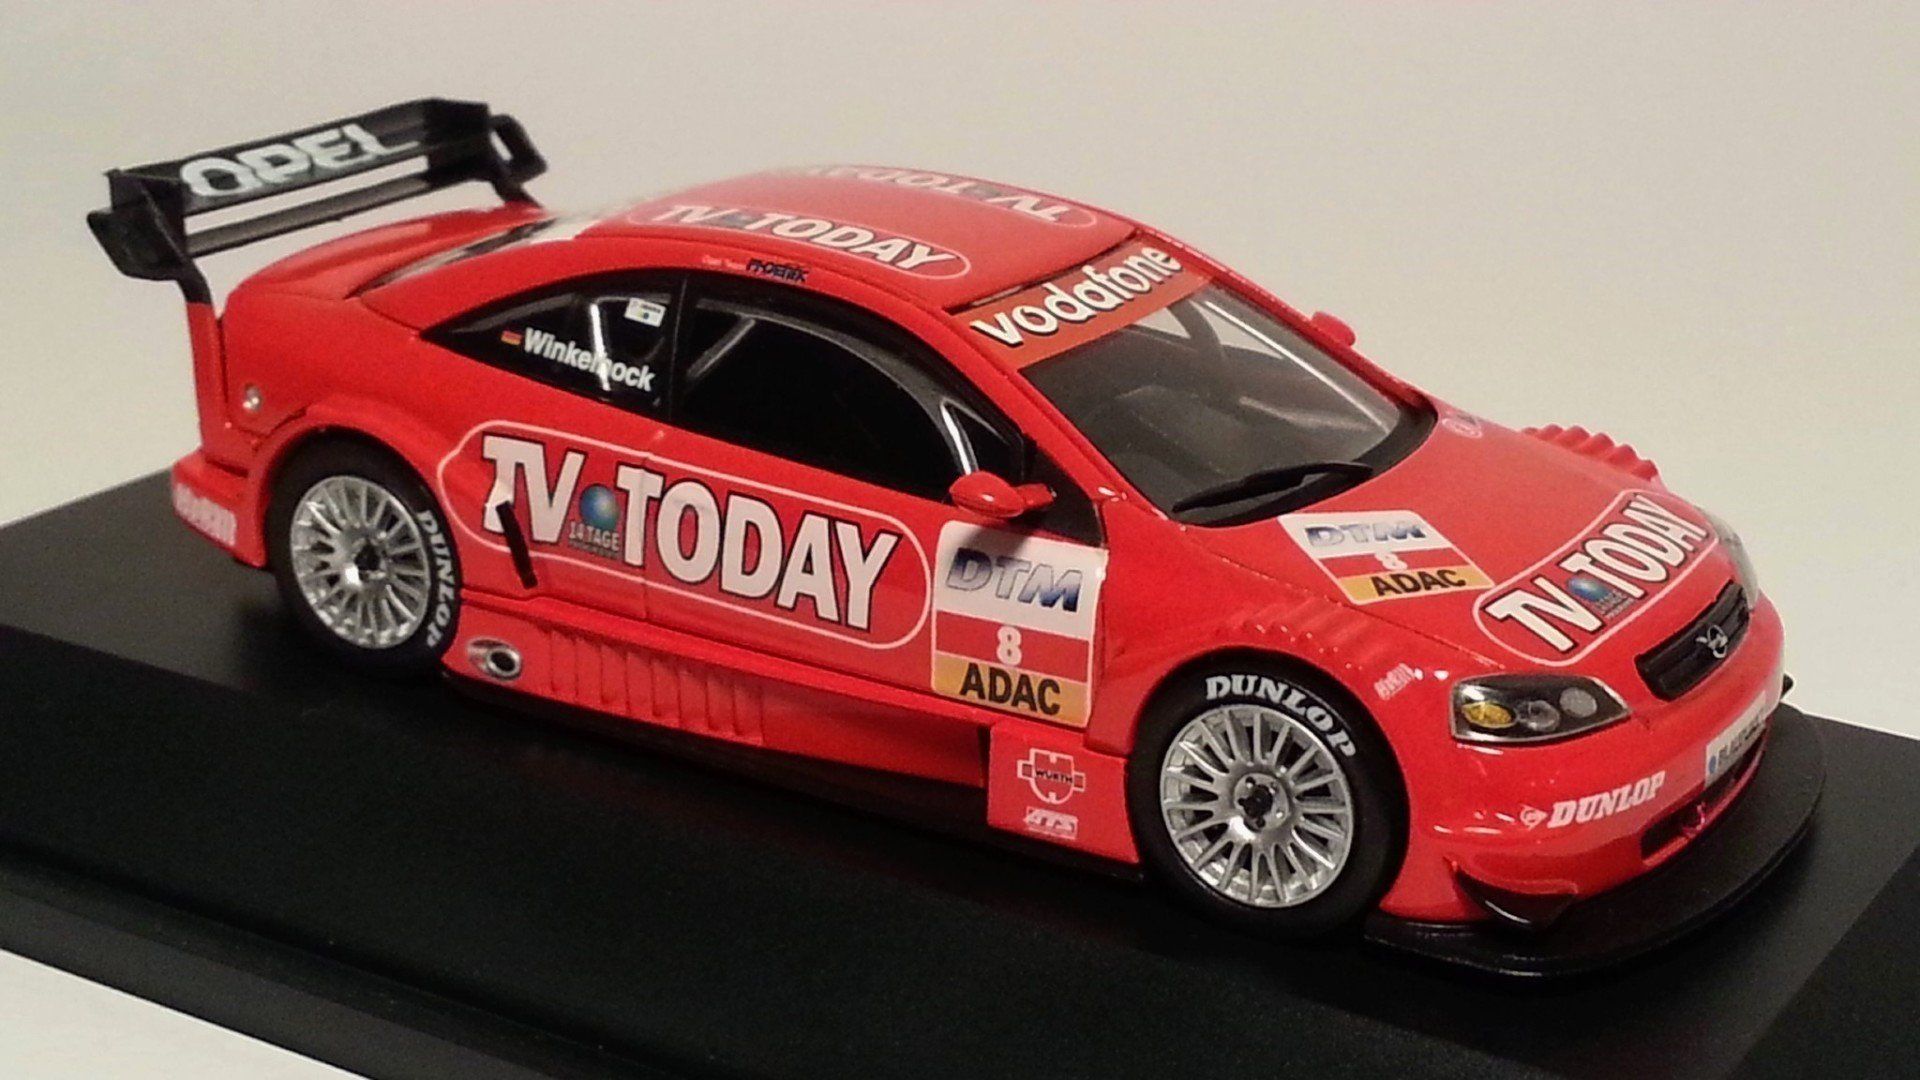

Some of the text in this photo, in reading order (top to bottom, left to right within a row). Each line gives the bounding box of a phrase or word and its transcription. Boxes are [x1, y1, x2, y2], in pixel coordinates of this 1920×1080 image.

[179, 122, 420, 197] OPEL
[651, 204, 741, 224] TV
[742, 212, 957, 270] TODAY
[969, 246, 1184, 346] vodafone
[481, 433, 906, 634] TV TODAY
[1304, 520, 1427, 548] DTM
[1374, 549, 1409, 572] 8
[416, 508, 456, 648] DUNLOP
[945, 546, 1083, 613] DTM
[1370, 569, 1467, 598] ADAC
[1483, 493, 1711, 653] TV TODAY
[996, 625, 1023, 667] 8
[959, 662, 1062, 716] ADAC
[1204, 673, 1357, 758] DUNLOP
[1546, 769, 1667, 830] DUNLOP
